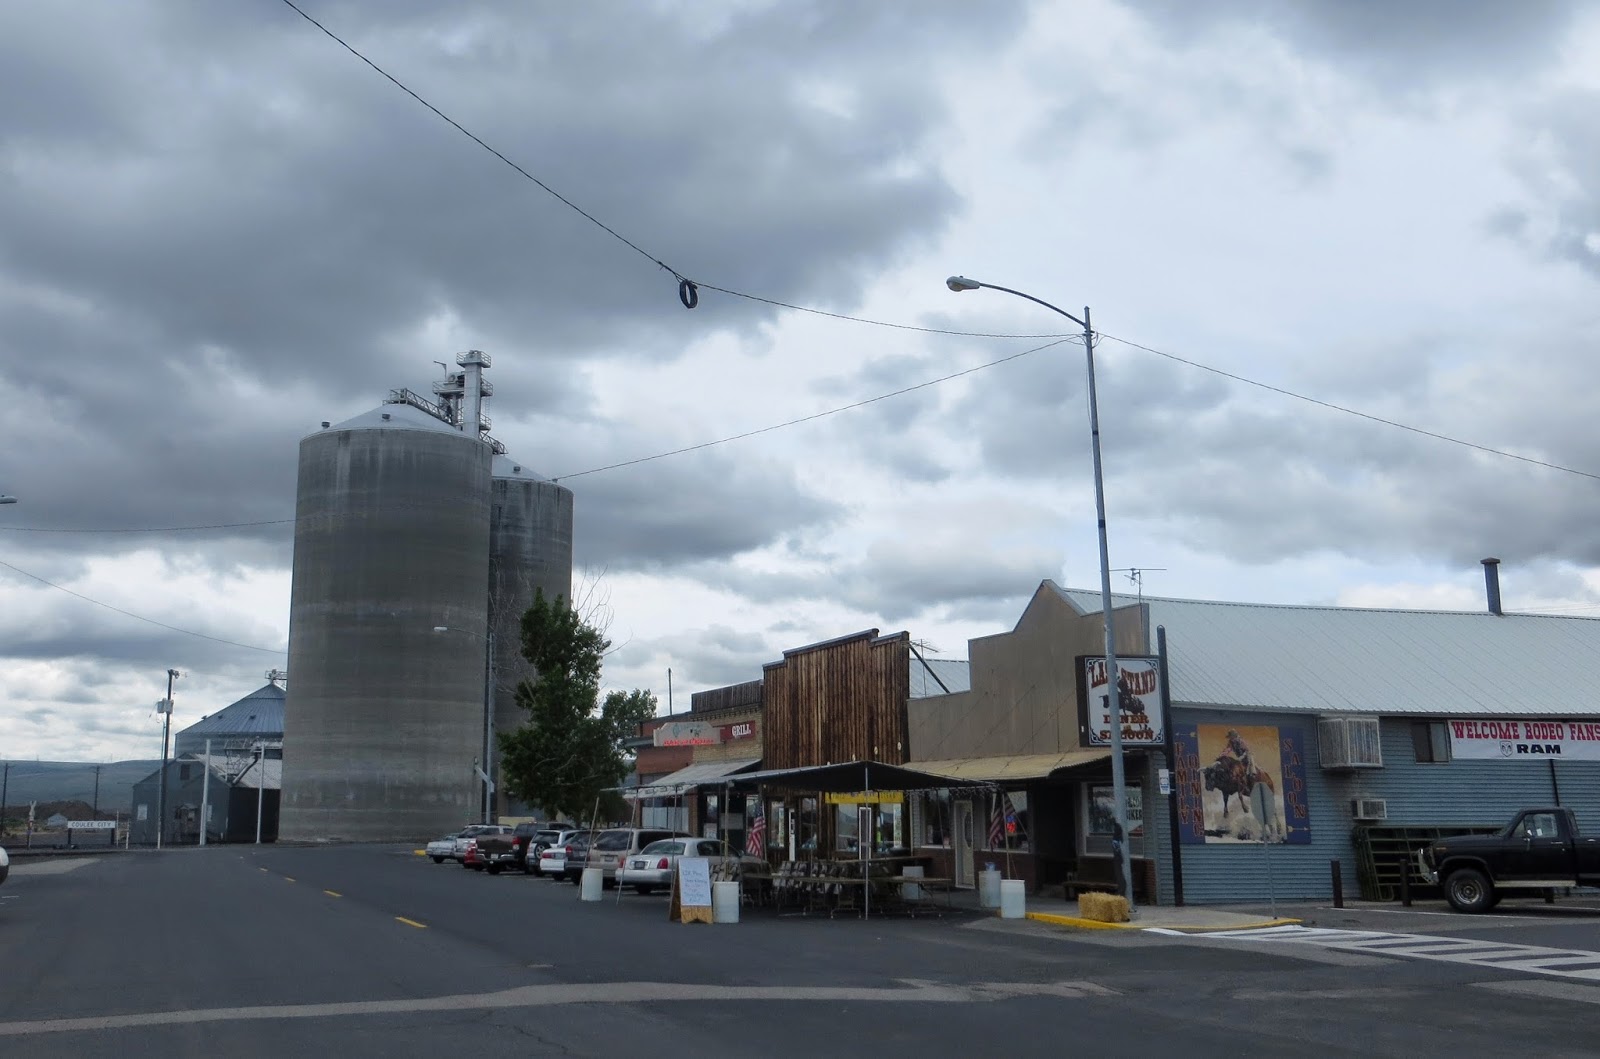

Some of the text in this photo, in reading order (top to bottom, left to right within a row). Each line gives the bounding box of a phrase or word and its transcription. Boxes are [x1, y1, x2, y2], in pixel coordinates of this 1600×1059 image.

[1103, 714, 1149, 724] DNER
[731, 723, 751, 738] GRILL
[1101, 730, 1154, 740] SLOON
[1452, 721, 1520, 740] WELCOME
[1524, 722, 1564, 741] RODEO
[1516, 743, 1561, 754] RAM
[1175, 741, 1190, 825] FAMILY
[1283, 737, 1306, 818] SALOON
